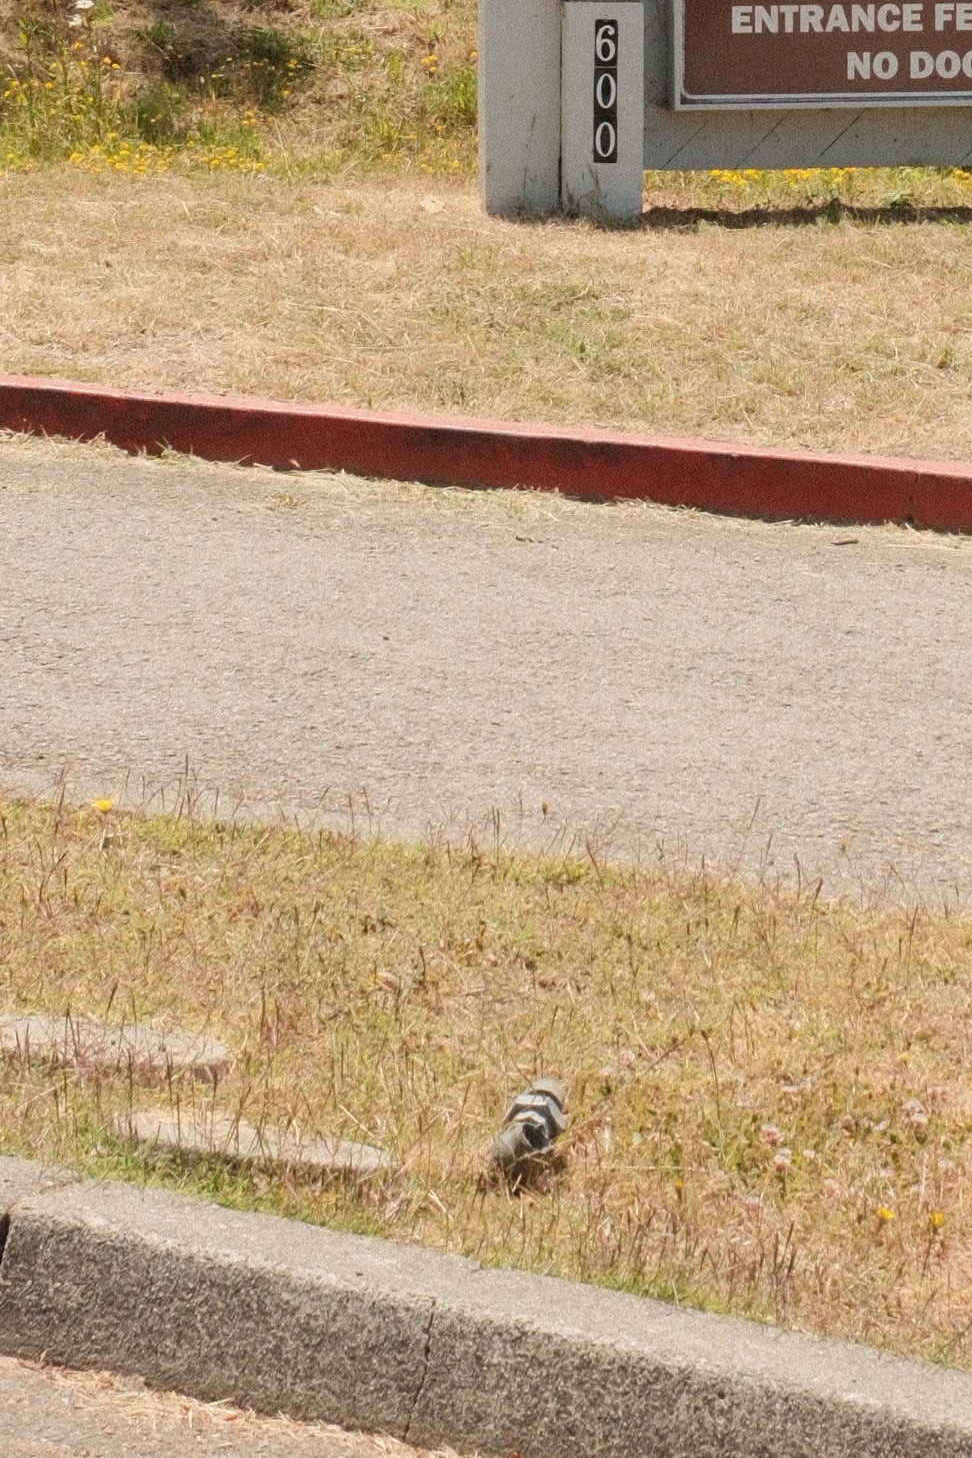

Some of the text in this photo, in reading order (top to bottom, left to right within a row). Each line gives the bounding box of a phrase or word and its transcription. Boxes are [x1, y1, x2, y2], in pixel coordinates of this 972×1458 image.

[731, 3, 924, 34] ENTRANCE
[847, 51, 899, 80] NO
[595, 24, 617, 158] 600
